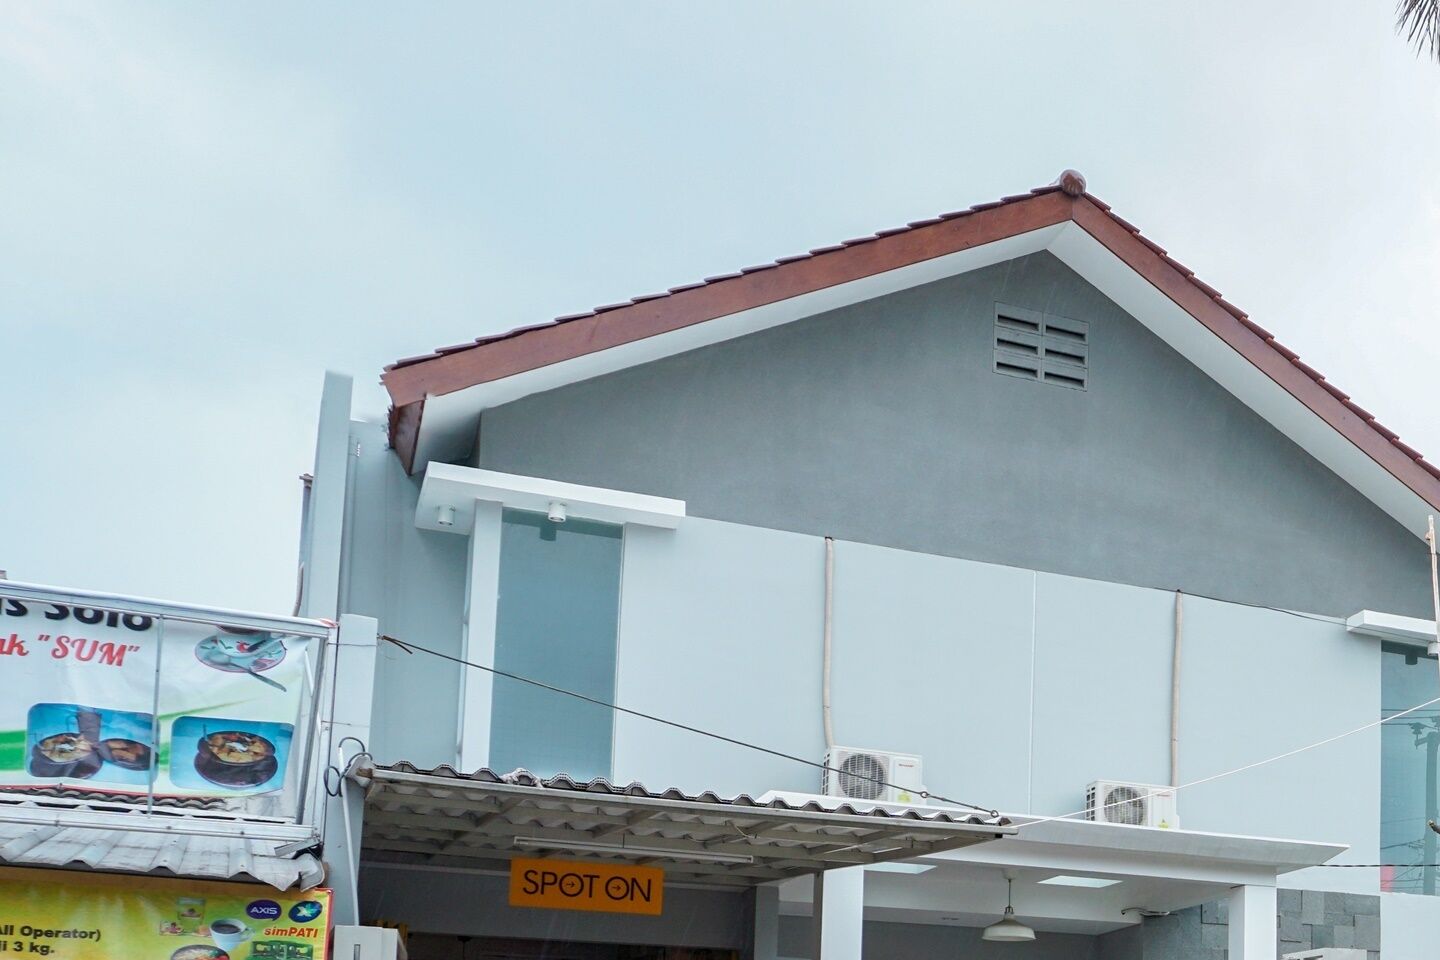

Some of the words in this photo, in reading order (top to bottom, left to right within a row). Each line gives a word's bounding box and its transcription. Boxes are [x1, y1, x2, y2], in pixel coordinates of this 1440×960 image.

[523, 869, 600, 898] SPOT
[605, 876, 652, 902] ON
[250, 906, 277, 915] AXIS
[20, 925, 101, 942] Operator)
[264, 926, 318, 939] simPATI
[13, 941, 24, 952] 3
[29, 942, 55, 956] kg.
